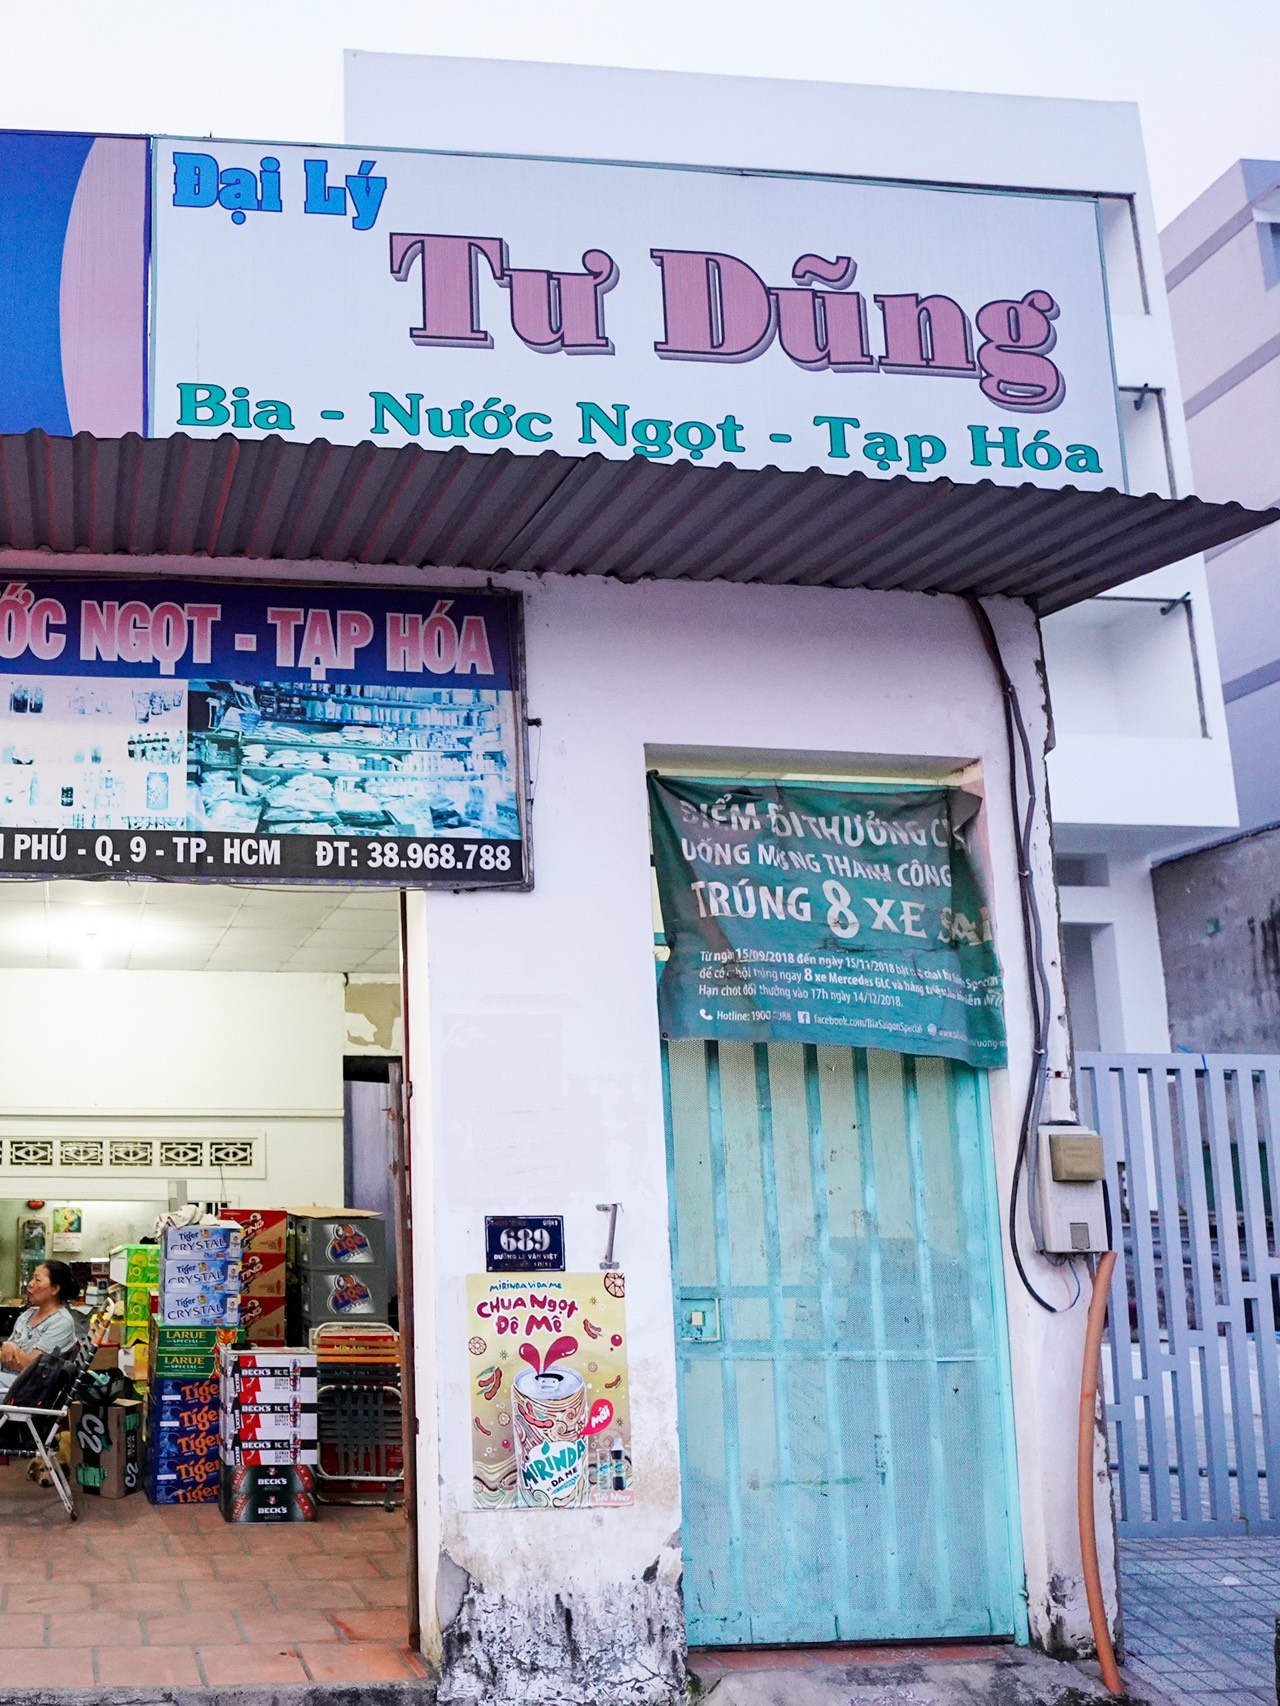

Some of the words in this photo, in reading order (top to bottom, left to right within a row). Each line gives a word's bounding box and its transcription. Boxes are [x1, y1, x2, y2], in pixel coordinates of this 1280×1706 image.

[172, 151, 283, 225] Đại
[303, 157, 388, 230] Lý
[389, 231, 619, 356] Tư
[651, 248, 1066, 414] Dũng
[176, 382, 294, 431] Bia
[370, 388, 553, 443] Nước
[578, 401, 741, 458] Ngọt
[814, 415, 946, 473] Tạp
[969, 423, 1104, 475] Hóa
[80, 600, 221, 675] NGỌT
[267, 606, 375, 680] TẠP
[386, 599, 495, 676] HÓA
[13, 825, 69, 863] PHÚ
[94, 836, 122, 866] Q.
[130, 836, 148, 862] 9
[173, 836, 214, 865] TP.
[223, 838, 282, 866] HCM
[316, 840, 360, 869] ĐT:
[366, 842, 512, 871] 38.968.788
[681, 837, 751, 866] UỐNG
[897, 859, 952, 887] CÔNG
[691, 878, 812, 921] TRÚNG
[822, 879, 860, 939] 8
[863, 897, 927, 939] XE
[736, 948, 795, 963] 15/09/2018
[804, 968, 813, 982] 8
[815, 974, 827, 983] xe
[829, 973, 873, 987] Mercedes
[874, 978, 891, 989] GLC
[699, 985, 718, 998] Hạn
[811, 988, 829, 1000] 17h
[717, 1010, 750, 1021] Hotline:
[751, 1010, 771, 1021] 1900
[170, 1238, 227, 1251] CRYSTAL
[500, 1228, 551, 1252] 689
[168, 1271, 225, 1284] CRYSTAL
[175, 1297, 196, 1308] Tiger
[476, 1296, 527, 1318] CHUA
[167, 1304, 224, 1320] CRYSTAL
[165, 1331, 206, 1339] LARUE
[164, 1356, 205, 1365] LARUE
[241, 1368, 272, 1376] BECK'S
[241, 1404, 272, 1412] BECK'S
[241, 1441, 272, 1449] BECK'S
[257, 1477, 288, 1485] BECK'S
[257, 1506, 288, 1514] BECK'S
